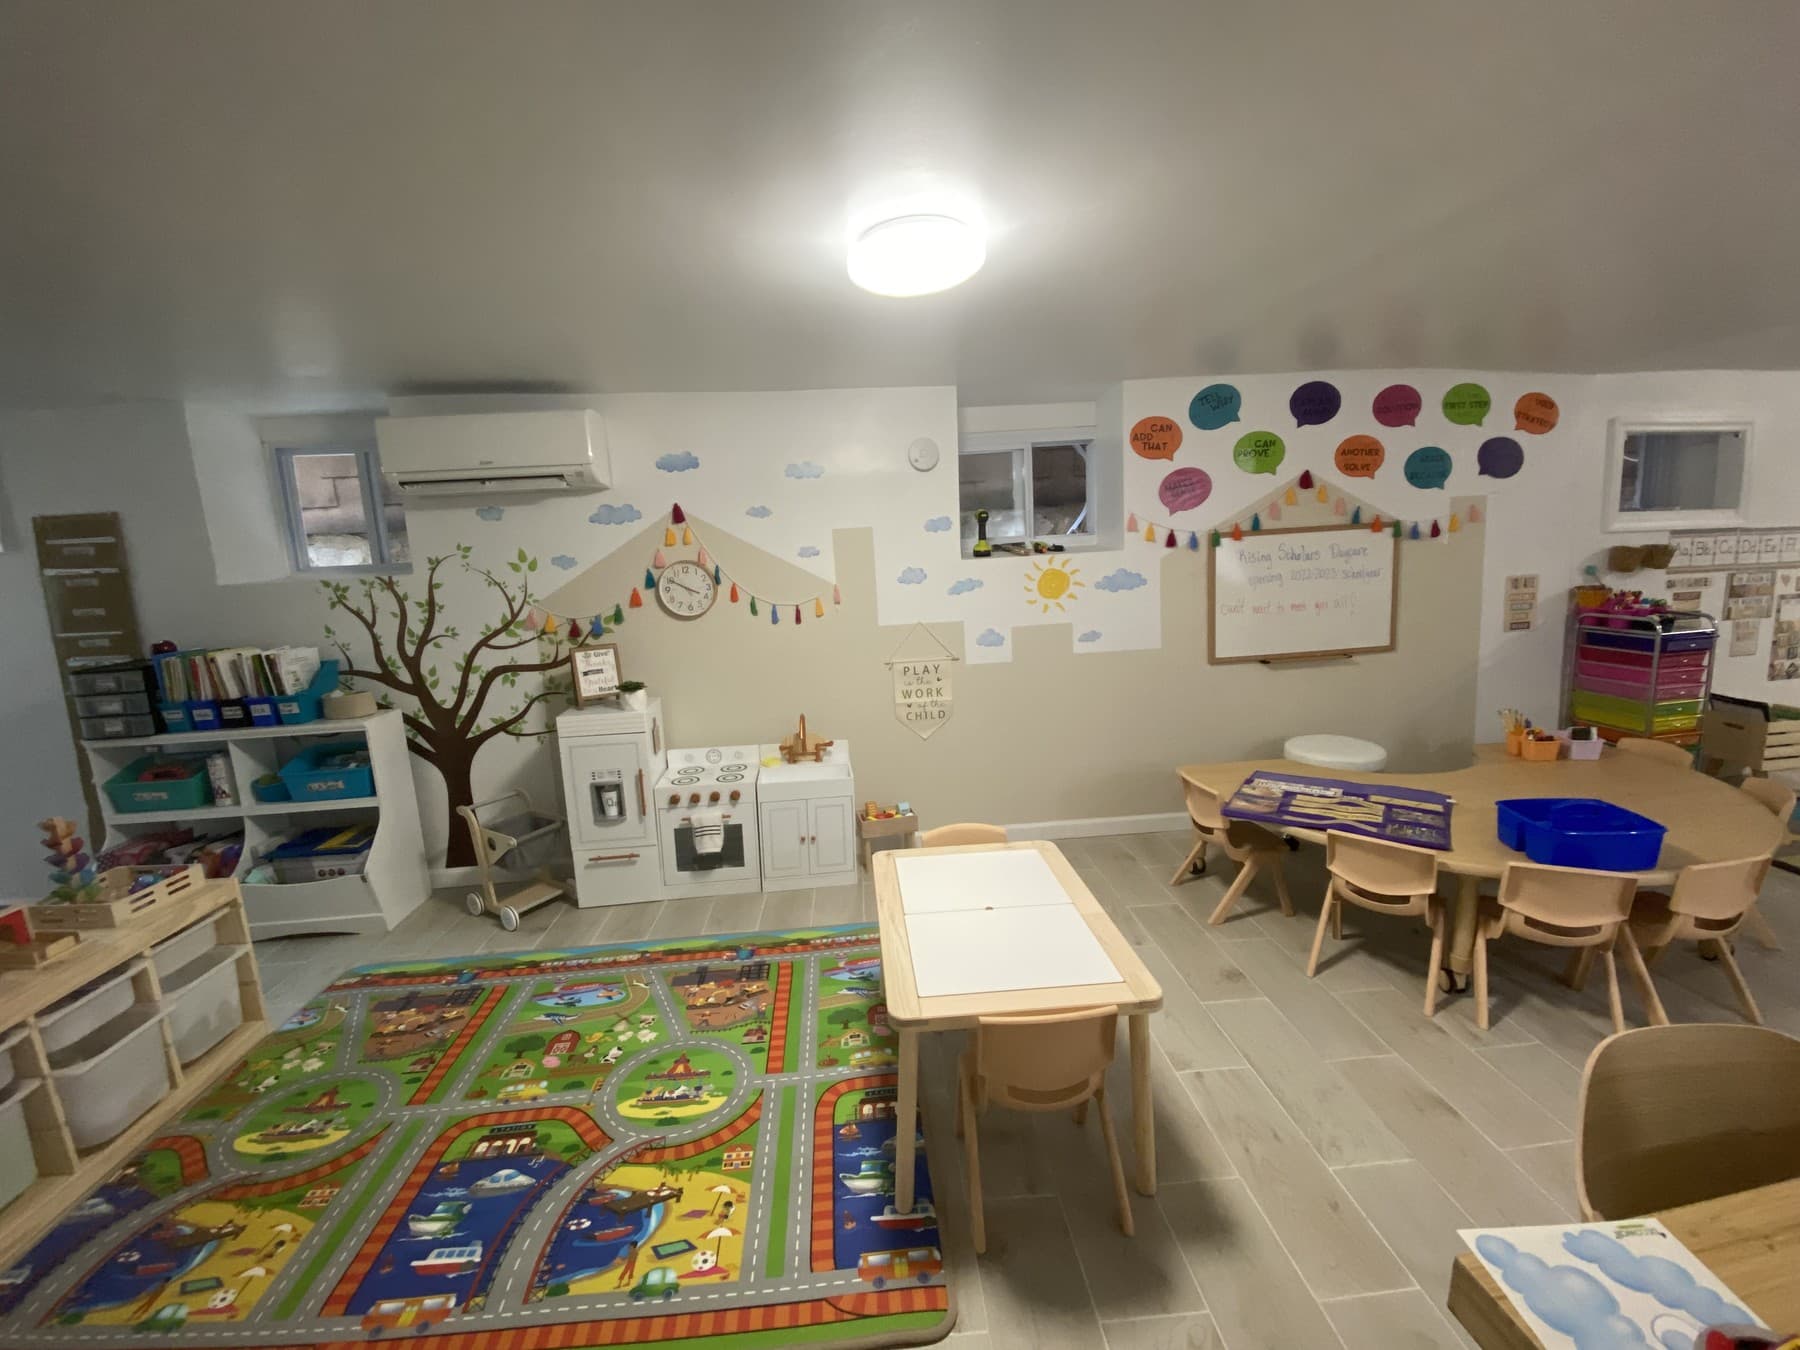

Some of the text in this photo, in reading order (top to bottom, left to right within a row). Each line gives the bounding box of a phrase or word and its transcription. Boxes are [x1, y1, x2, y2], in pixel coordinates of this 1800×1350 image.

[1151, 423, 1172, 433] CAN
[1132, 432, 1153, 442] ADD
[1142, 441, 1168, 451] THAT
[1254, 439, 1276, 449] CAN
[1238, 448, 1270, 457] PROVE
[1340, 448, 1380, 457] ANOTHER
[1239, 550, 1273, 570] Rising
[1278, 542, 1320, 561] Scholars
[903, 664, 940, 676] PLAY
[901, 687, 943, 699] WORK
[906, 710, 946, 721] CHILD
